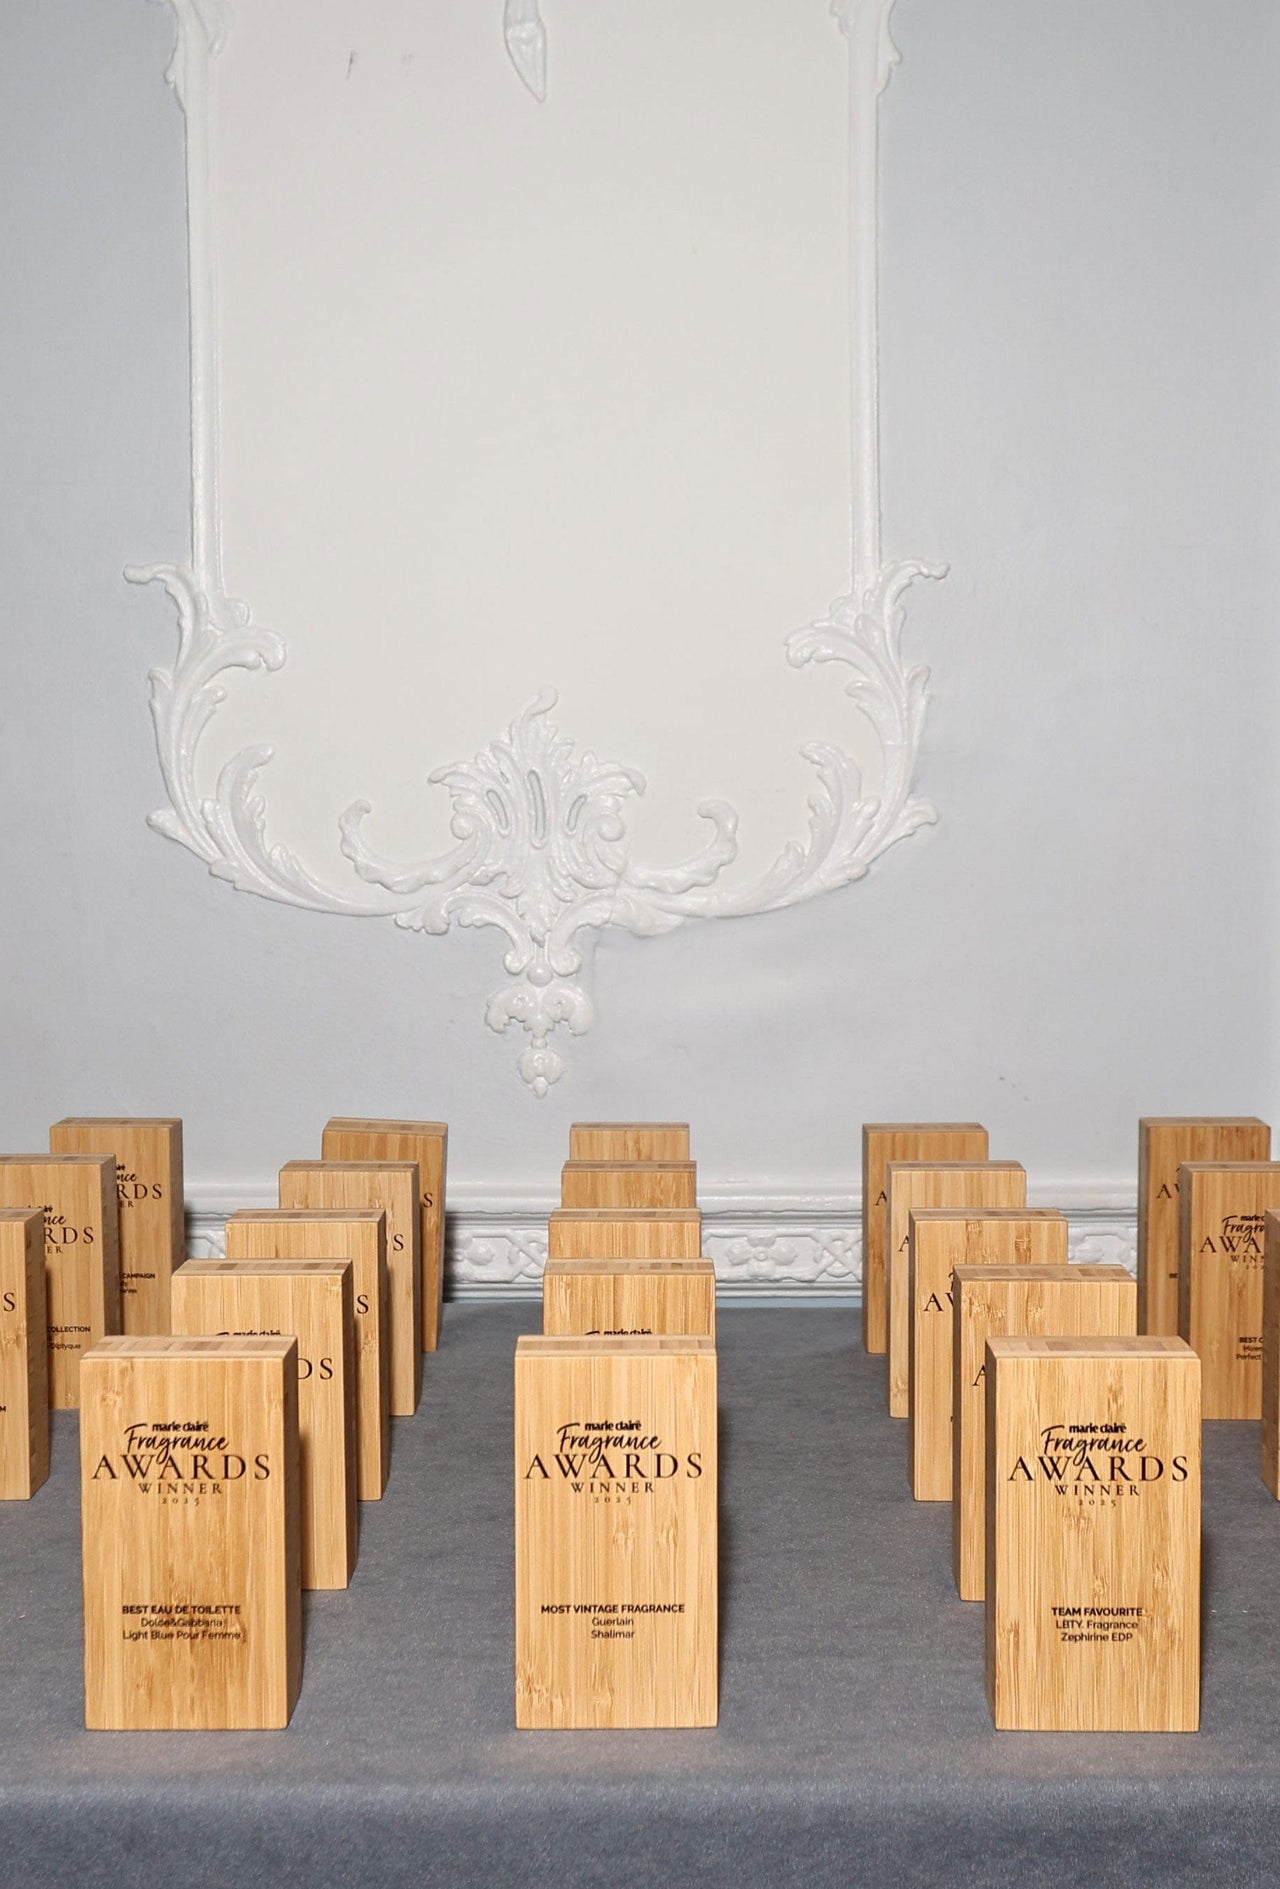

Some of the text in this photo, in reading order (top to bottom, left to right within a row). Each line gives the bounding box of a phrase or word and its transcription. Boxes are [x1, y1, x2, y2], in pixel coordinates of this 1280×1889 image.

[585, 1421, 613, 1431] marie
[1070, 1423, 1098, 1433] marie
[124, 1423, 229, 1464] Fragrance
[557, 1423, 661, 1464] Fragrance
[1041, 1425, 1147, 1466] Fragrance
[92, 1455, 270, 1480] AWARDS
[524, 1453, 702, 1479] AWARDS
[1008, 1456, 1188, 1482] AWARDS
[139, 1483, 222, 1493] WINNER
[571, 1482, 654, 1493] WINNER
[1055, 1485, 1139, 1496] WINNER
[162, 1498, 200, 1506] 2025
[594, 1497, 631, 1505] 2025
[122, 1606, 240, 1614] BEST EAU DE TOILETTE
[573, 1605, 619, 1613] VINTAGE
[621, 1604, 685, 1613] FRAGRANCE
[1052, 1608, 1142, 1616] TEAM FAVOURITE
[592, 1617, 634, 1626] Guerlain
[1087, 1620, 1138, 1631] Fragrance
[123, 1631, 240, 1640] Light Blue Pour Femme
[591, 1630, 634, 1639] Shalimar
[1112, 1633, 1132, 1641] EDP
